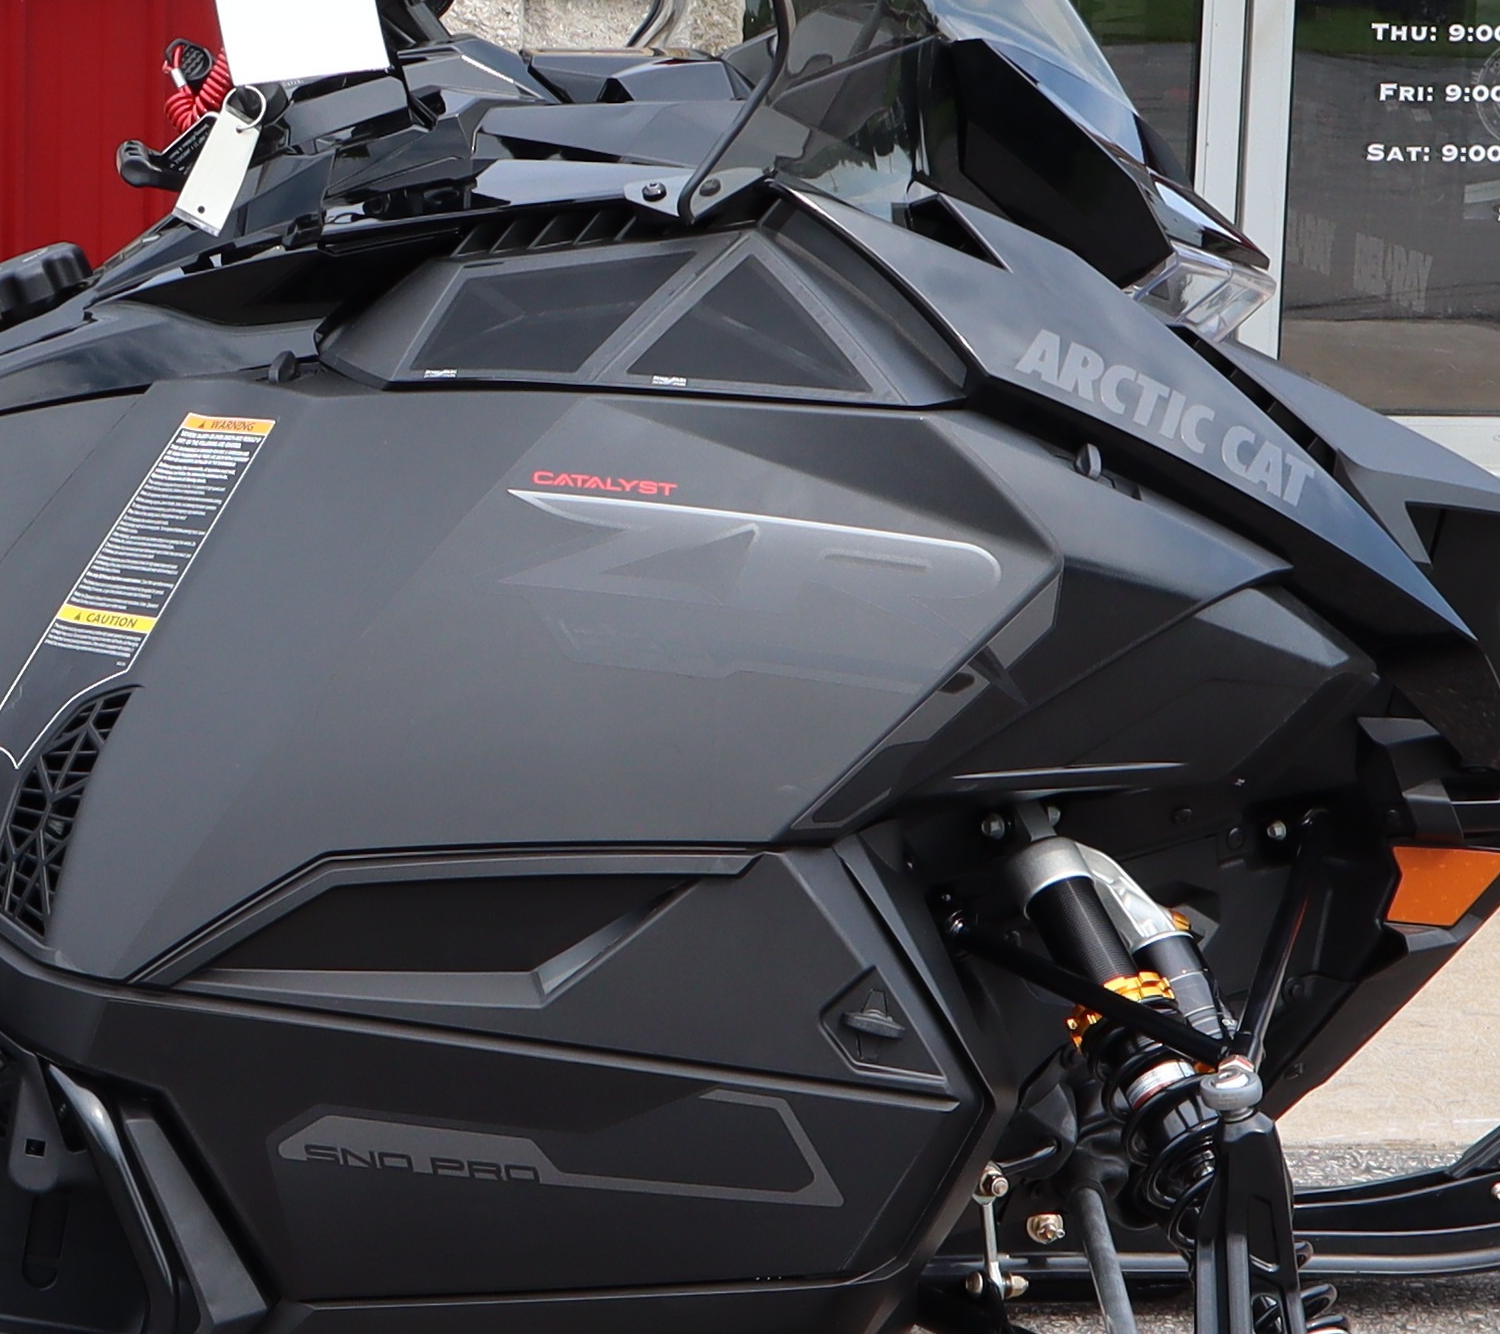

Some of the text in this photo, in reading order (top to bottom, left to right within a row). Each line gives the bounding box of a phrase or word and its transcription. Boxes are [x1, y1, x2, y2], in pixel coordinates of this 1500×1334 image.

[210, 420, 256, 432] WARNING
[1014, 327, 1316, 508] ARCTIC CAT
[532, 470, 679, 497] CATALYST
[85, 612, 139, 629] CAUTION
[303, 1143, 541, 1184] SNO PRO
